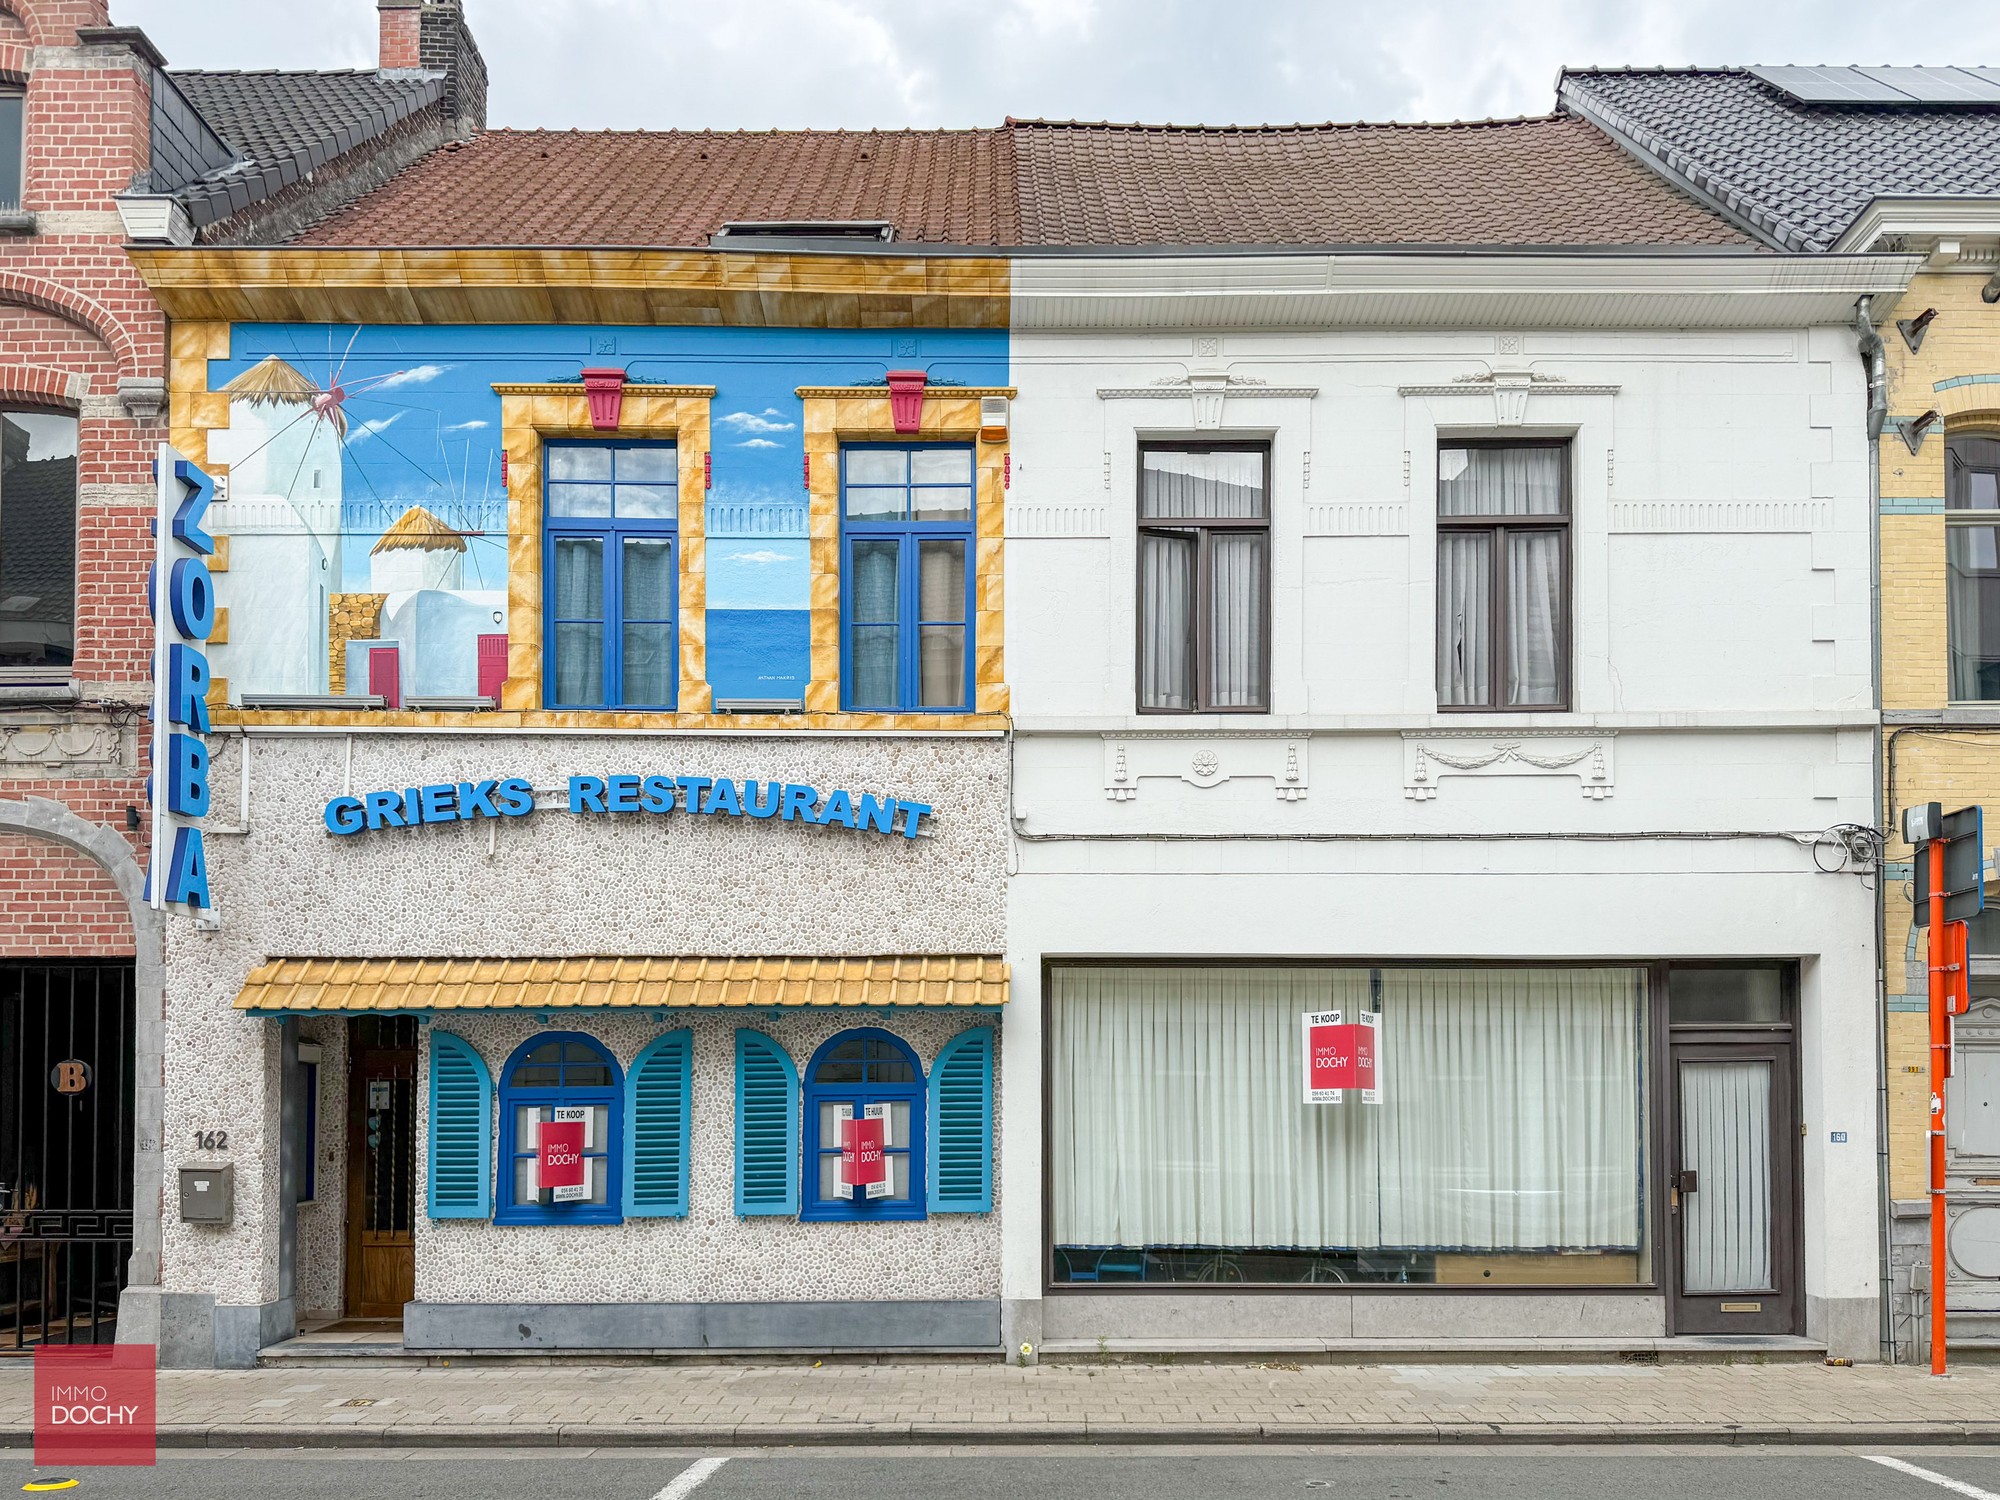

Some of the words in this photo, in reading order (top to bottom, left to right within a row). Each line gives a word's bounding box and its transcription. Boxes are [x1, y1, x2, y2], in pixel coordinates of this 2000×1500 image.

[165, 459, 215, 909] ZORBA
[324, 777, 534, 836] GRIEKS
[568, 774, 932, 840] RESTAURANT
[1311, 1015, 1319, 1024] TE
[1321, 1013, 1340, 1023] KOOP
[1315, 1046, 1336, 1056] IMMO
[1315, 1056, 1348, 1068] DOCHY
[56, 1062, 88, 1093] B
[557, 1110, 565, 1119] TE
[566, 1110, 585, 1119] KOOP
[865, 1107, 871, 1116] TE
[871, 1107, 883, 1116] HUUR
[194, 1130, 228, 1151] 162
[862, 1140, 874, 1150] IMMO
[548, 1144, 568, 1152] IMMO
[548, 1154, 579, 1166] DOCHY
[861, 1150, 882, 1163] DOCHY
